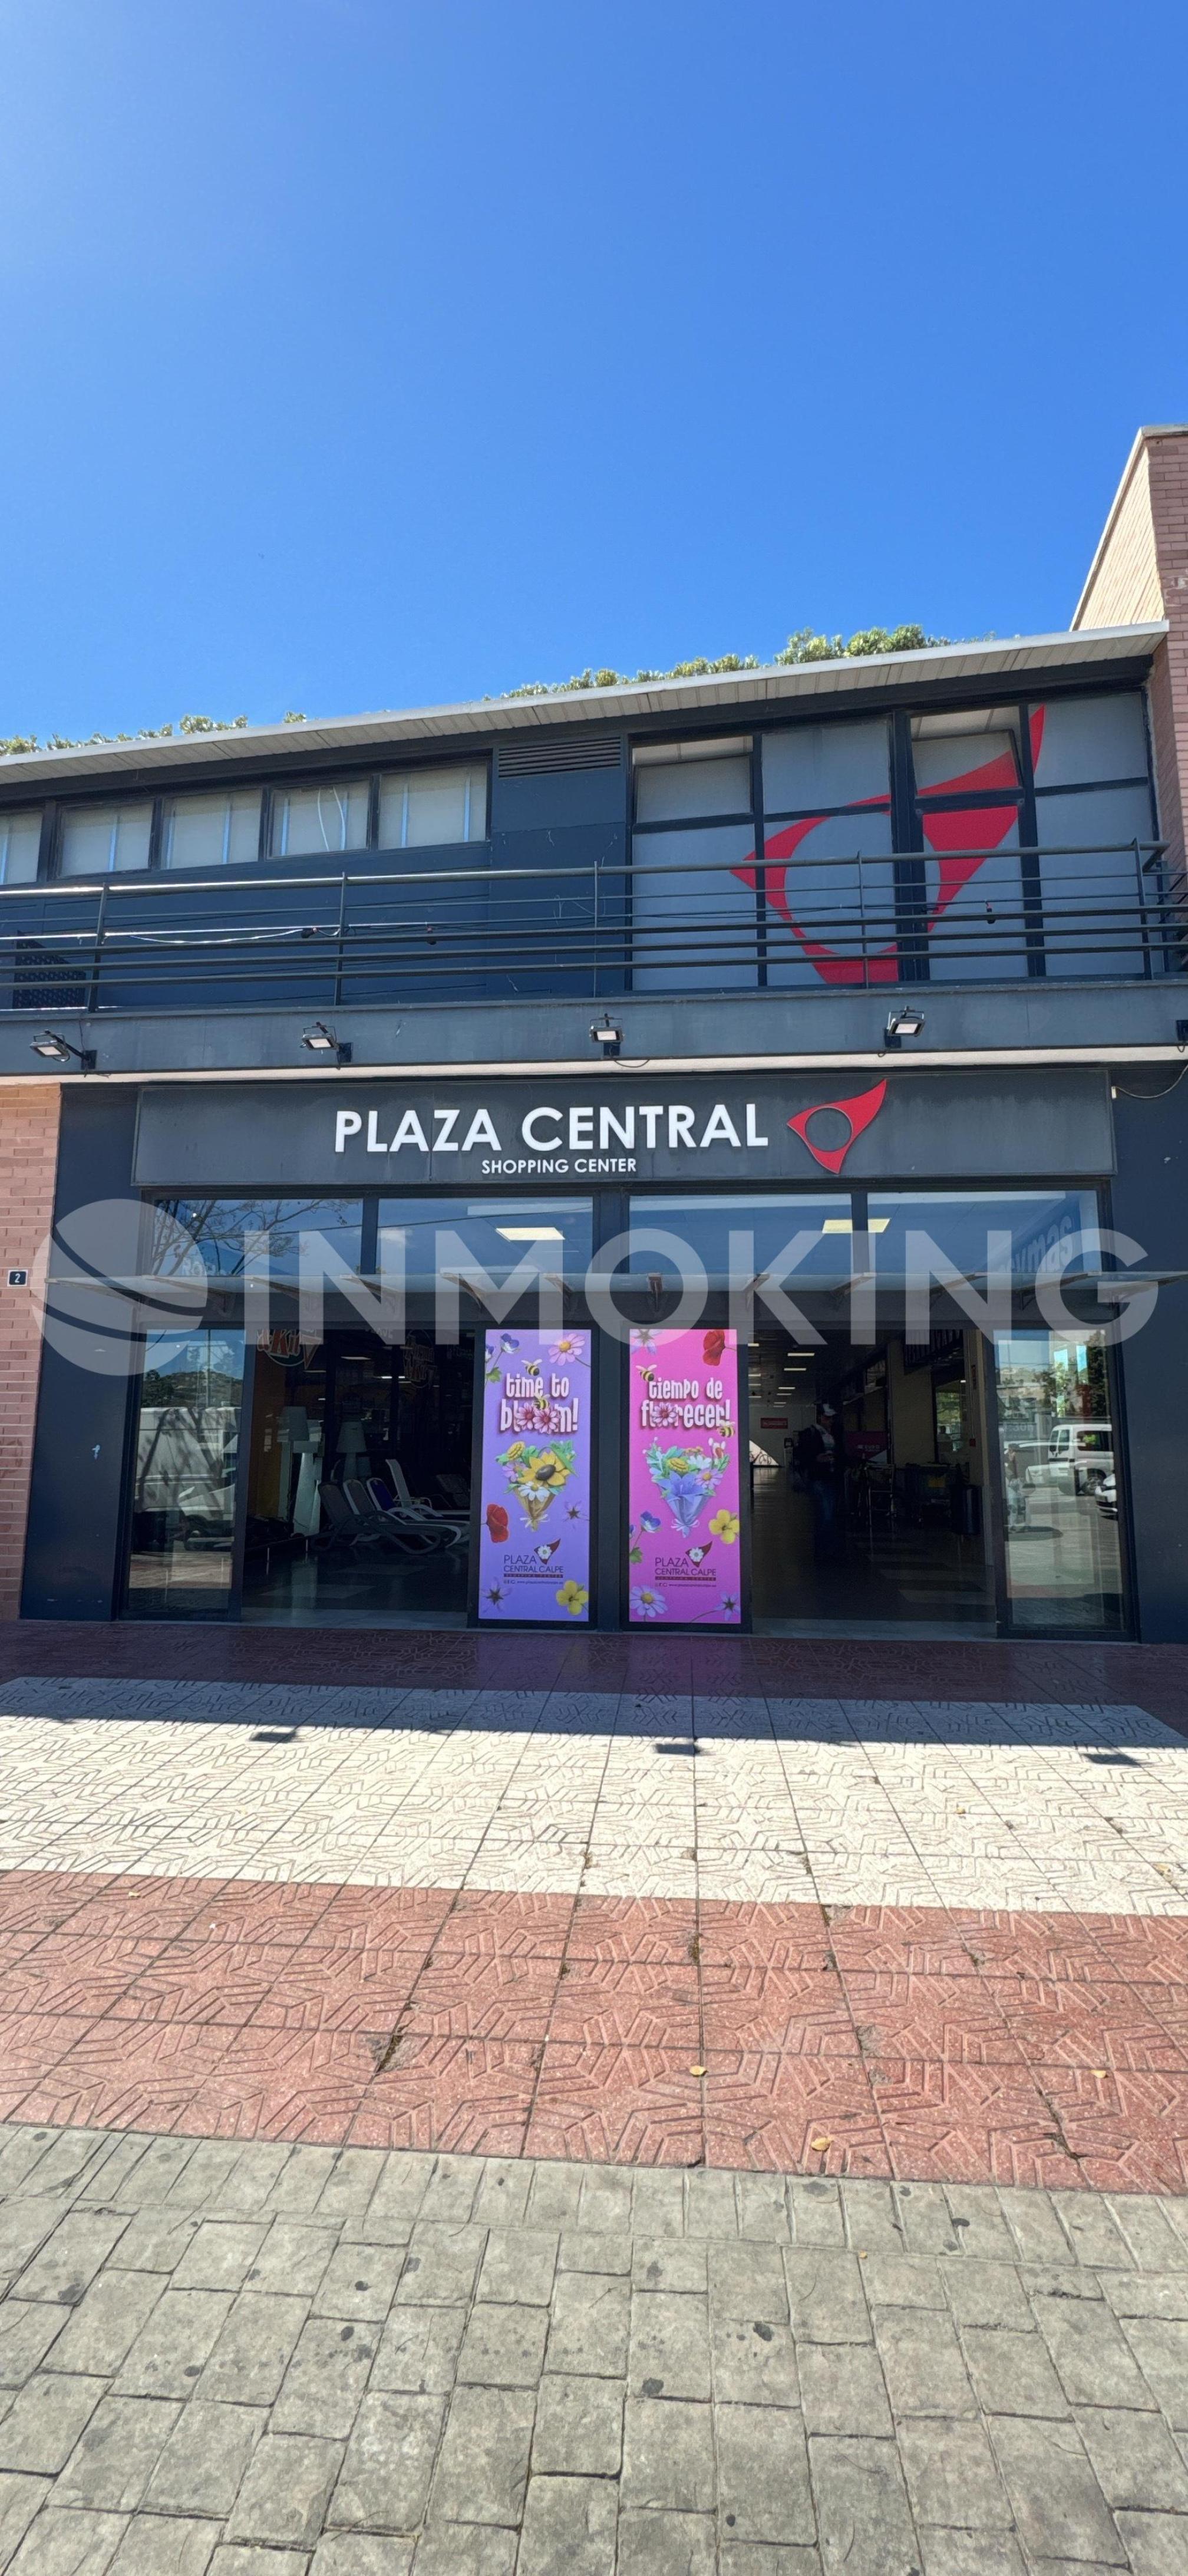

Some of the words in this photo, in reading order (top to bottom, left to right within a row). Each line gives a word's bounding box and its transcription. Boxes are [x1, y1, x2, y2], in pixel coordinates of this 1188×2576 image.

[334, 1108, 502, 1152] PLAZA
[522, 1103, 768, 1151] CENTRAL
[481, 1159, 569, 1174] SHOPPING
[574, 1158, 636, 1172] CENTER
[14, 1273, 21, 1283] 2
[506, 1373, 543, 1398] time
[551, 1373, 569, 1397] to
[649, 1377, 699, 1399] tiempo
[706, 1377, 722, 1399] de
[500, 1398, 579, 1433] blm!
[641, 1399, 730, 1428] flrecer!
[504, 1554, 537, 1564] PLAZA
[655, 1557, 689, 1567] PLAZA
